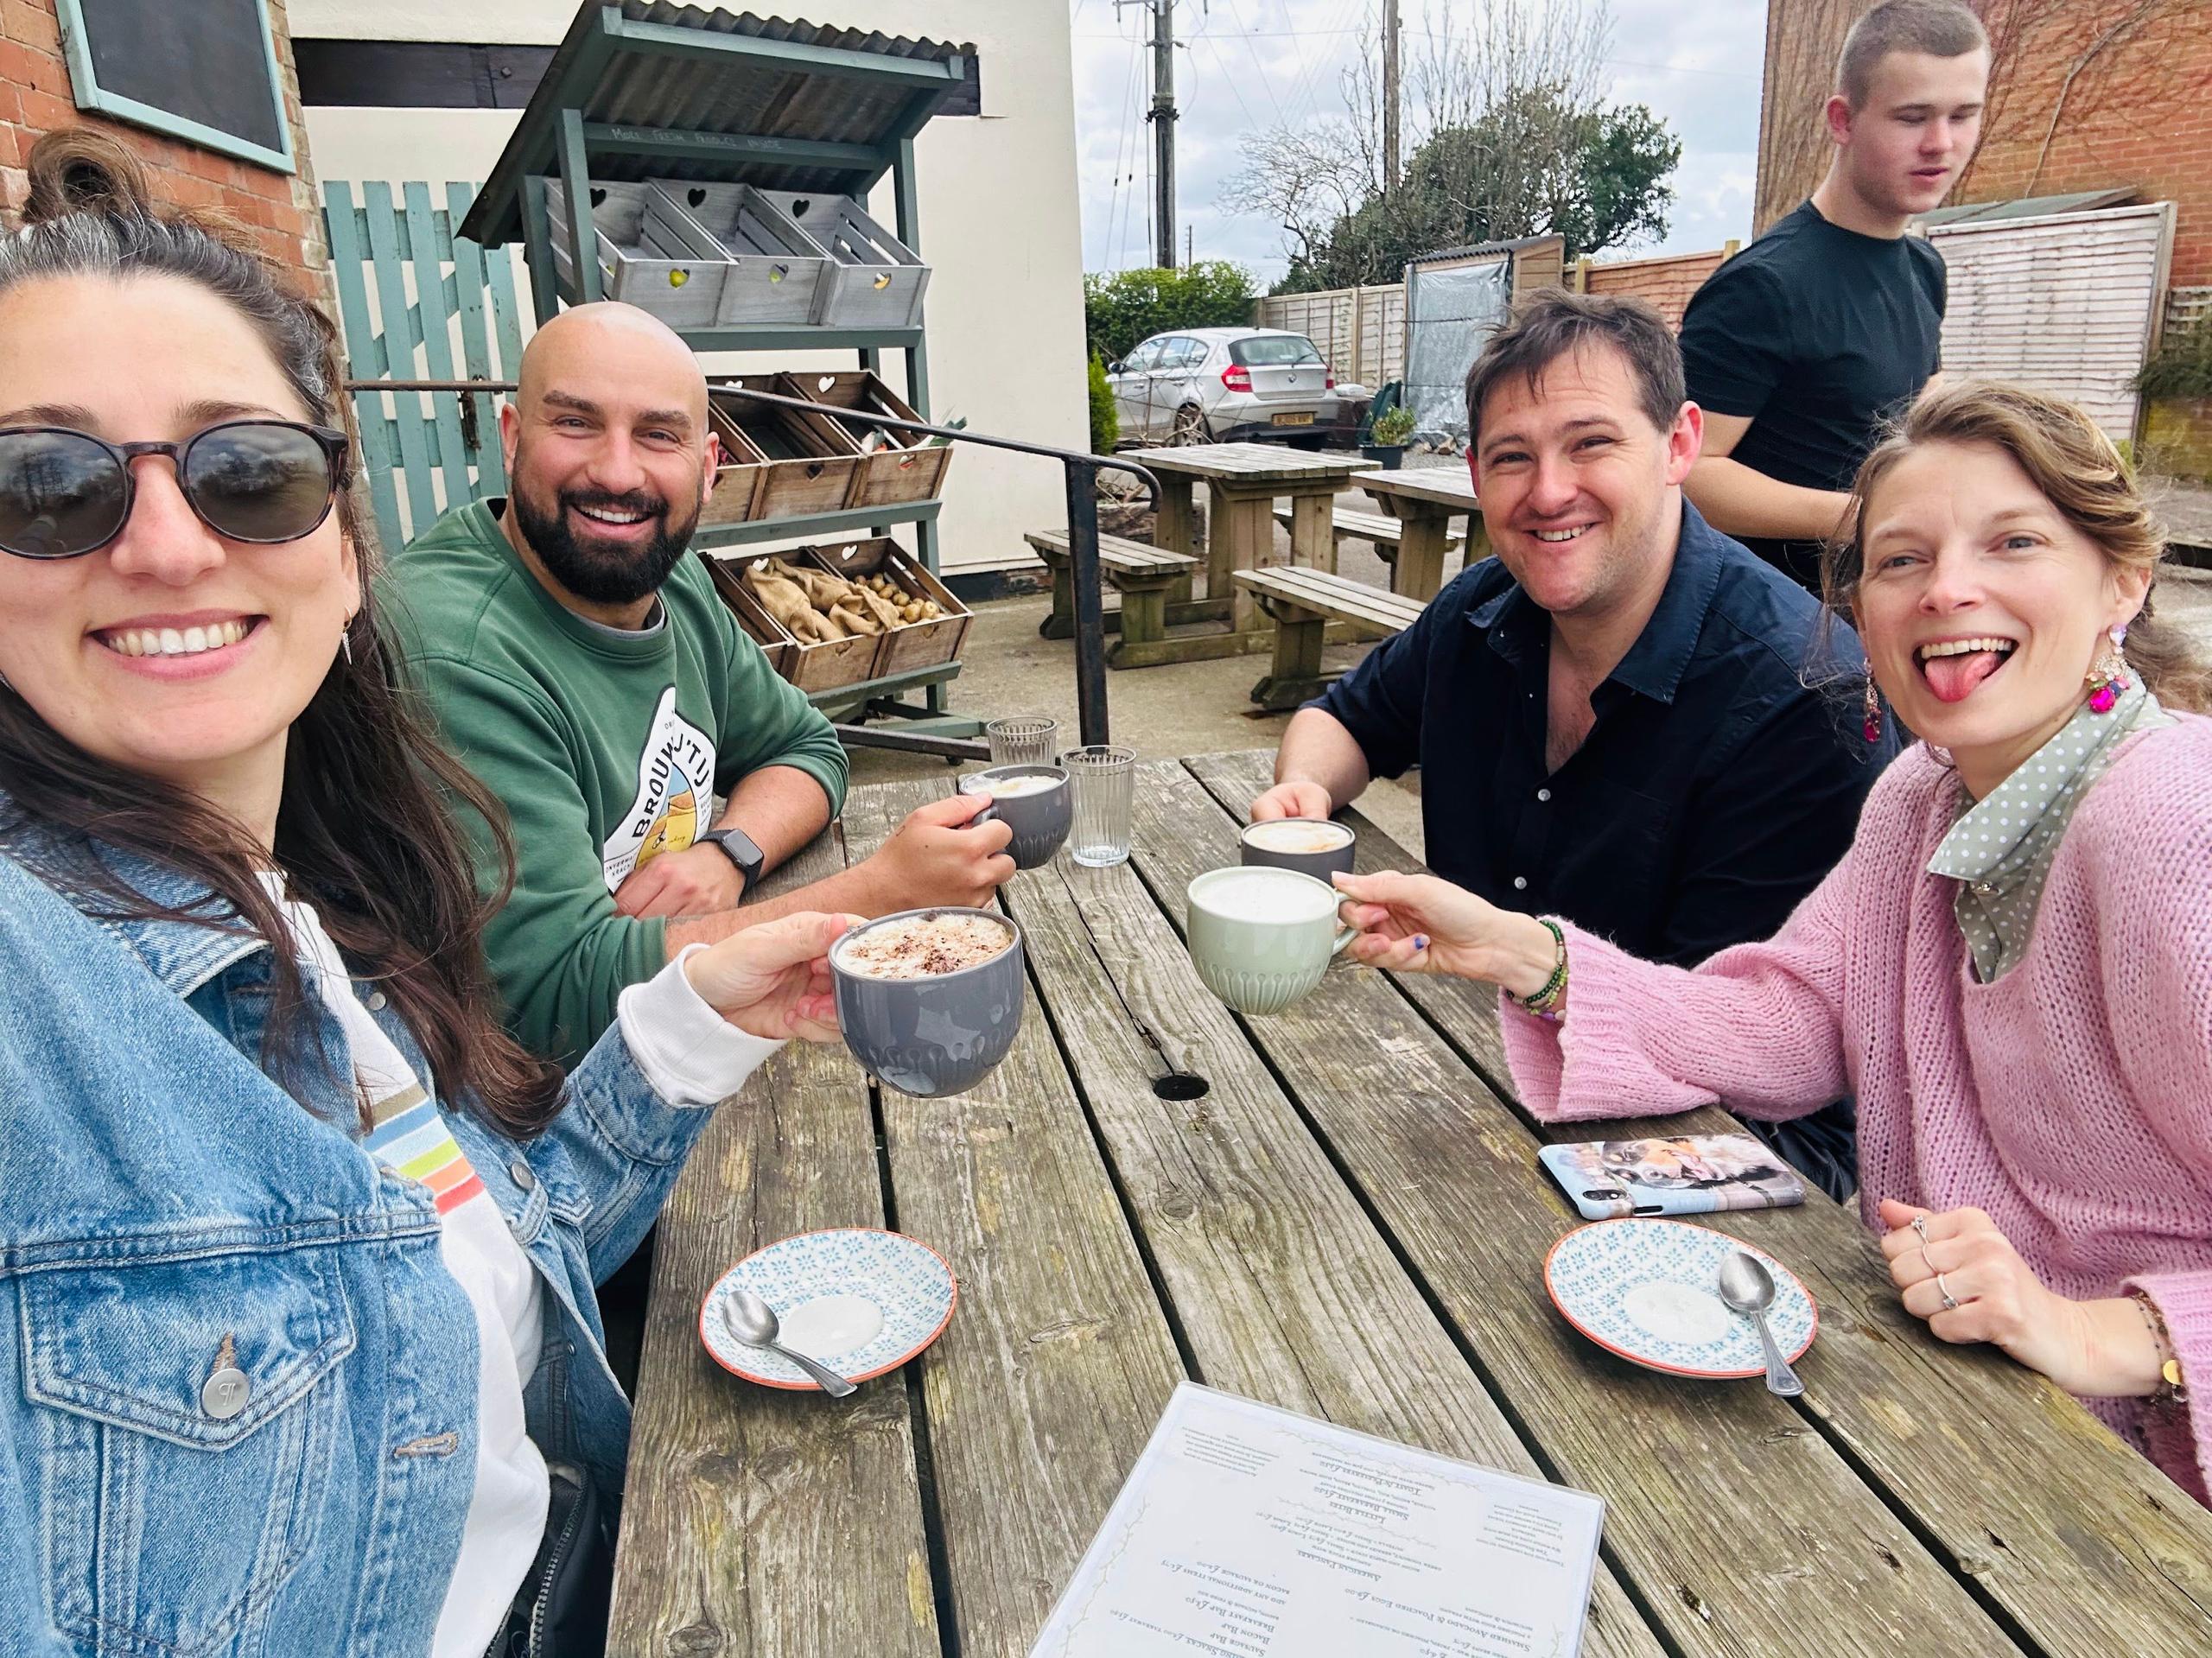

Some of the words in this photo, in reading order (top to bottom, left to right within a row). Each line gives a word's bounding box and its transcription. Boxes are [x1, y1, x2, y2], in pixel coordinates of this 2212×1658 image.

[1295, 1550, 1337, 1568] PANCAKES
[1181, 1567, 1205, 1579] ITEMS
[1220, 1568, 1251, 1582] SAUSAGE
[1337, 1563, 1381, 1582] AMERICAN
[1205, 1575, 1253, 1595] ADDITIONAL
[1264, 1583, 1290, 1595] BACON
[1254, 1591, 1269, 1600] ANY
[1270, 1596, 1286, 1605] ADD
[1370, 1595, 1393, 1608] EGGS
[1208, 1604, 1227, 1617] BAP
[1394, 1602, 1433, 1621] POACHED
[1227, 1610, 1275, 1633] BREAKFAST
[1435, 1615, 1445, 1623] &
[1219, 1621, 1239, 1634] BAP
[1446, 1618, 1487, 1638] AVOCADO
[1208, 1631, 1227, 1644] BAP
[1239, 1628, 1270, 1644] BACON
[1489, 1632, 1530, 1652] SMASHED
[1227, 1637, 1266, 1657] SAUSAGE
